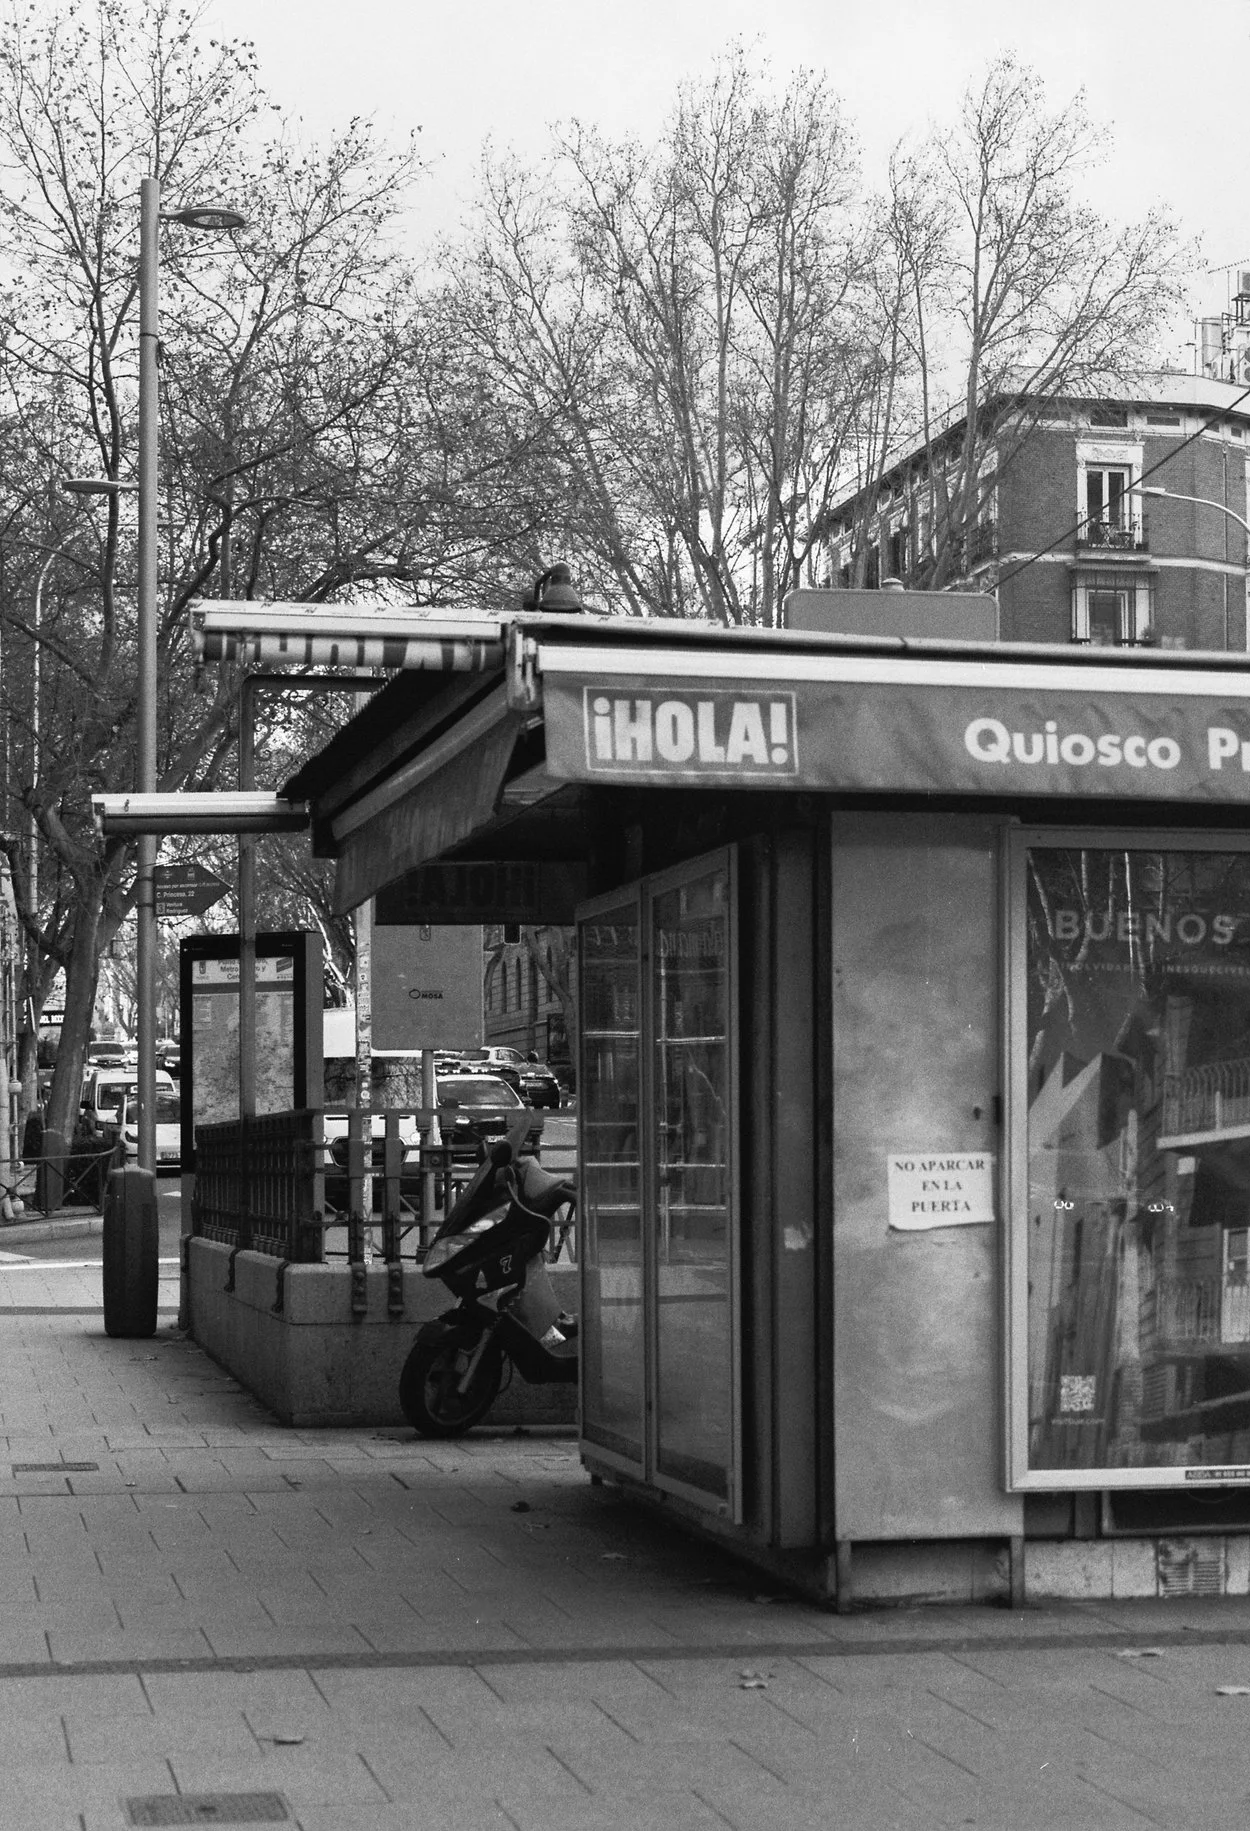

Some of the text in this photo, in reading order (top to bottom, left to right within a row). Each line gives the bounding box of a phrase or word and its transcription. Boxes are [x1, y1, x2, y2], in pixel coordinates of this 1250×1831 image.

[592, 696, 789, 767] ¡HOLA!
[964, 717, 1181, 770] Quiosco
[1054, 910, 1237, 945] BUENOS
[894, 1159, 986, 1172] NO APARCAR
[922, 1180, 963, 1191] EN LA
[911, 1200, 971, 1212] PUERTA
